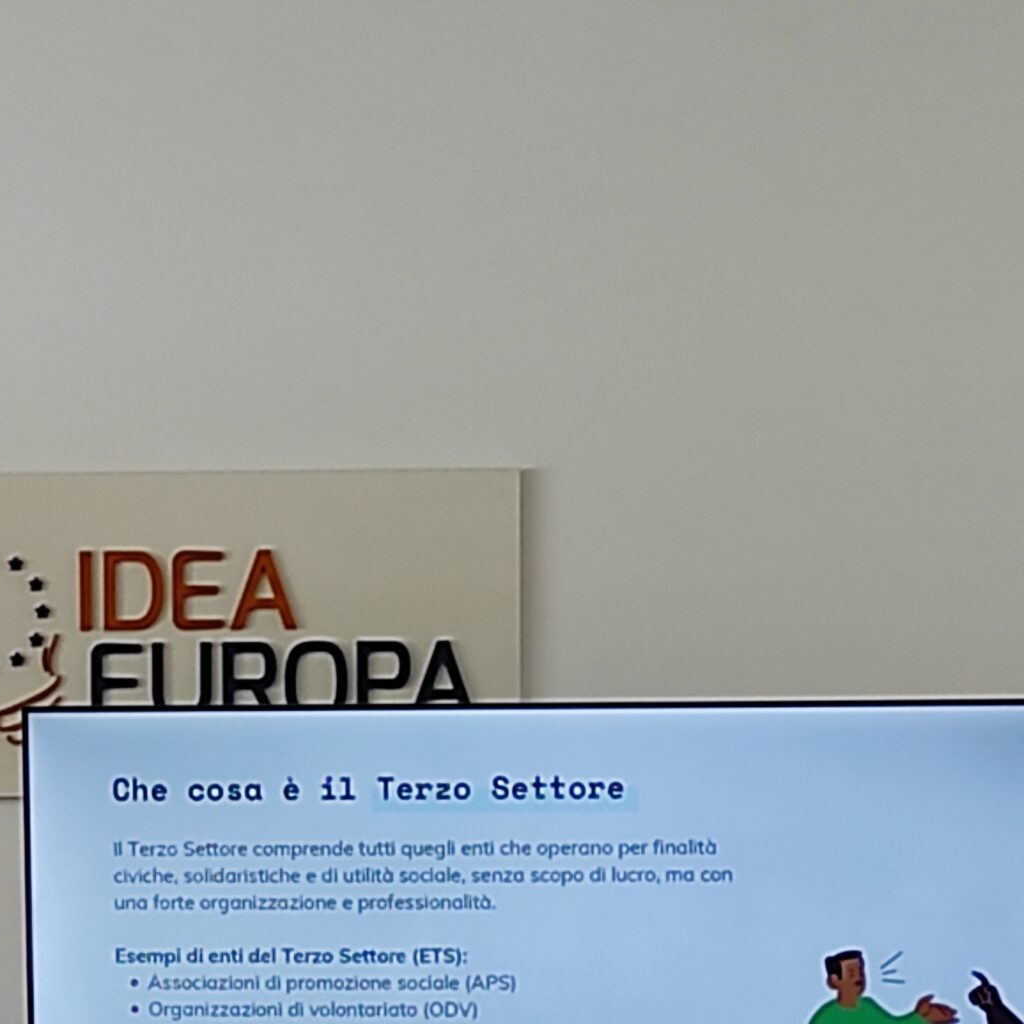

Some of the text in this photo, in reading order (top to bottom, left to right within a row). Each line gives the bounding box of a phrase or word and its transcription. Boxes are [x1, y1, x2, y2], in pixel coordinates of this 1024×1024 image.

[79, 550, 299, 632] IDEA
[89, 640, 473, 704] EUROPA
[113, 775, 624, 802] Che cosa è il Terzo Settore
[127, 841, 178, 857] Terzo
[183, 841, 248, 857] Settore
[252, 840, 354, 860] comprende
[358, 841, 396, 857] tutti
[401, 840, 455, 860] quegli
[461, 841, 494, 857] enti
[500, 839, 531, 856] che
[536, 843, 614, 859] operano
[618, 843, 648, 859] per
[653, 839, 717, 856] finalità
[113, 865, 733, 887] civiche, solidaristiche e di utilità sociale, senza scopo di lucro, ma con
[114, 893, 496, 915] una forte organizzazione e professionalità.
[115, 947, 467, 968] Esempi di enti del Terzo Settore (ETS):
[147, 974, 516, 995] Associazioni di promozione sociale (APS)
[148, 1001, 478, 1021] Organizzazioni di volontariato (ODV)
